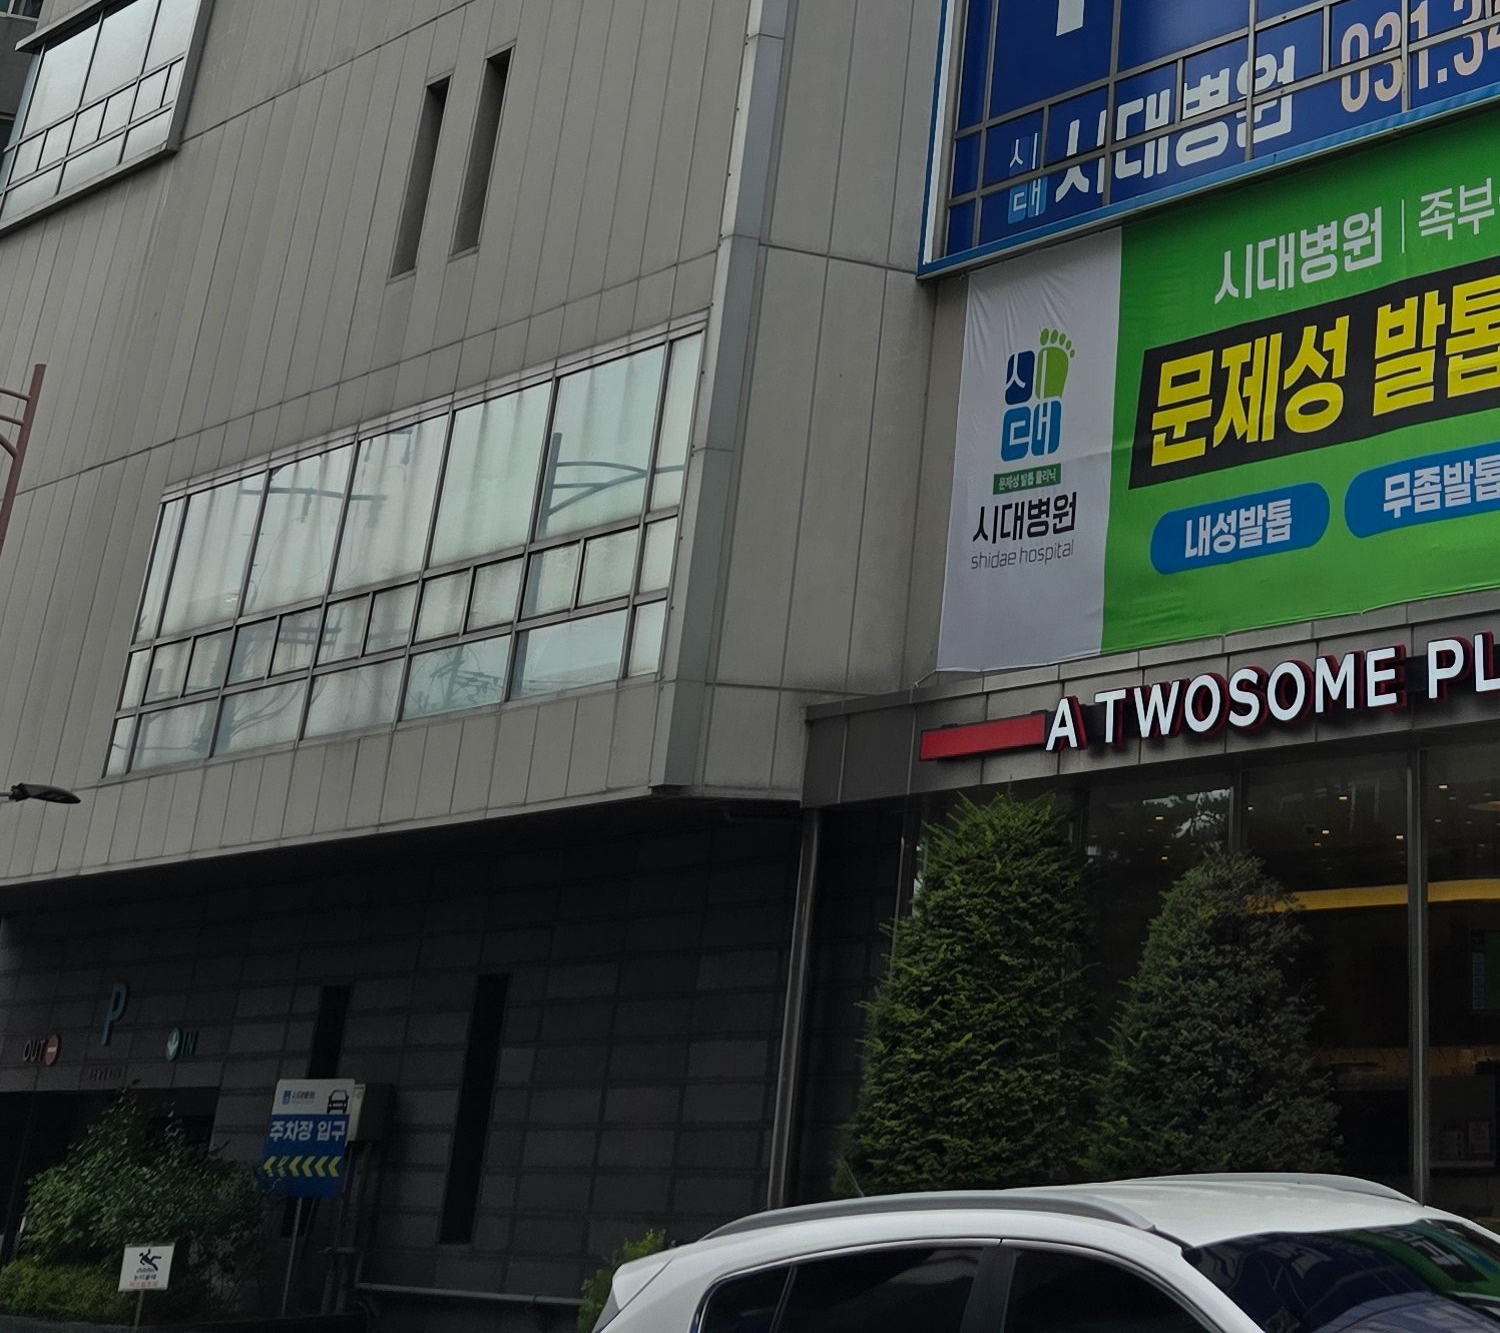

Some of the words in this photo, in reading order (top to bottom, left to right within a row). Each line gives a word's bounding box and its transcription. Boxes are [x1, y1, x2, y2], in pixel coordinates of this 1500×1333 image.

[1055, 45, 1296, 203] 시대병원
[1213, 207, 1384, 305] 시대병원
[1150, 314, 1349, 467] 문제성
[999, 476, 1019, 491] 문제성
[1020, 472, 1034, 487] 발톱
[1035, 468, 1057, 484] 클리닉
[973, 492, 1077, 544] 시대병원
[1185, 494, 1292, 559] 내성발톱
[971, 550, 1017, 570] shidae
[1019, 539, 1075, 566] hospital
[1046, 695, 1081, 751] A
[1094, 645, 1400, 745] TWOSOME
[101, 981, 129, 1046] P
[22, 1038, 47, 1063] OUT
[269, 1119, 314, 1142] 주차장
[316, 1119, 347, 1142] 입구
